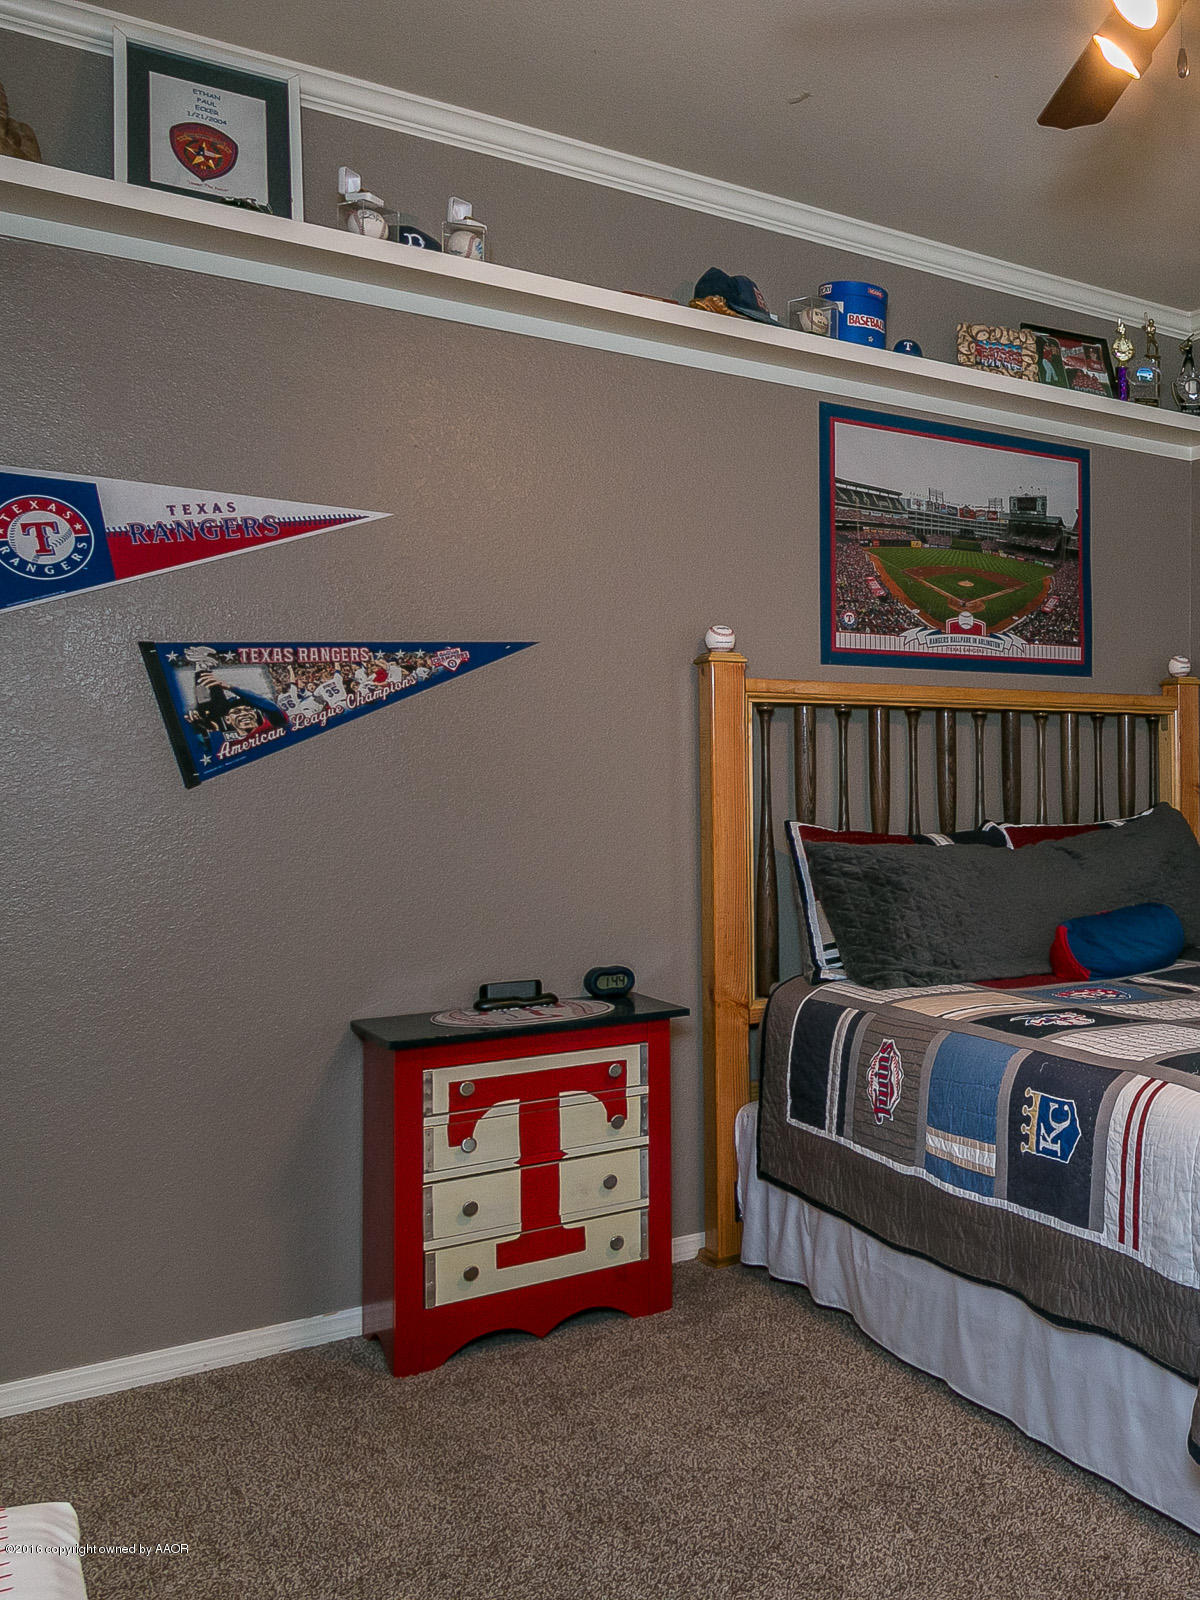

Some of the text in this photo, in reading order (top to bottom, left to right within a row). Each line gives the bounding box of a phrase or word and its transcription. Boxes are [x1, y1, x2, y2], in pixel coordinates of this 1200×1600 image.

[192, 88, 221, 101] ETHAN
[196, 97, 217, 108] PAUL
[847, 313, 885, 333] BASEBAL
[903, 340, 913, 352] T
[0, 500, 74, 522] TEXAS
[166, 501, 237, 516] TEXAS
[20, 520, 60, 556] T
[128, 514, 281, 545] RANGERS
[0, 541, 88, 576] RANGERS
[929, 636, 949, 645] RANGERS
[950, 635, 971, 644] BALLPARK
[238, 647, 370, 663] TEXAS RANGERS
[325, 685, 340, 698] 35
[281, 700, 296, 711] 36
[217, 673, 418, 760] American League Champions
[1039, 1102, 1071, 1157] KC
[447, 1060, 629, 1270] T
